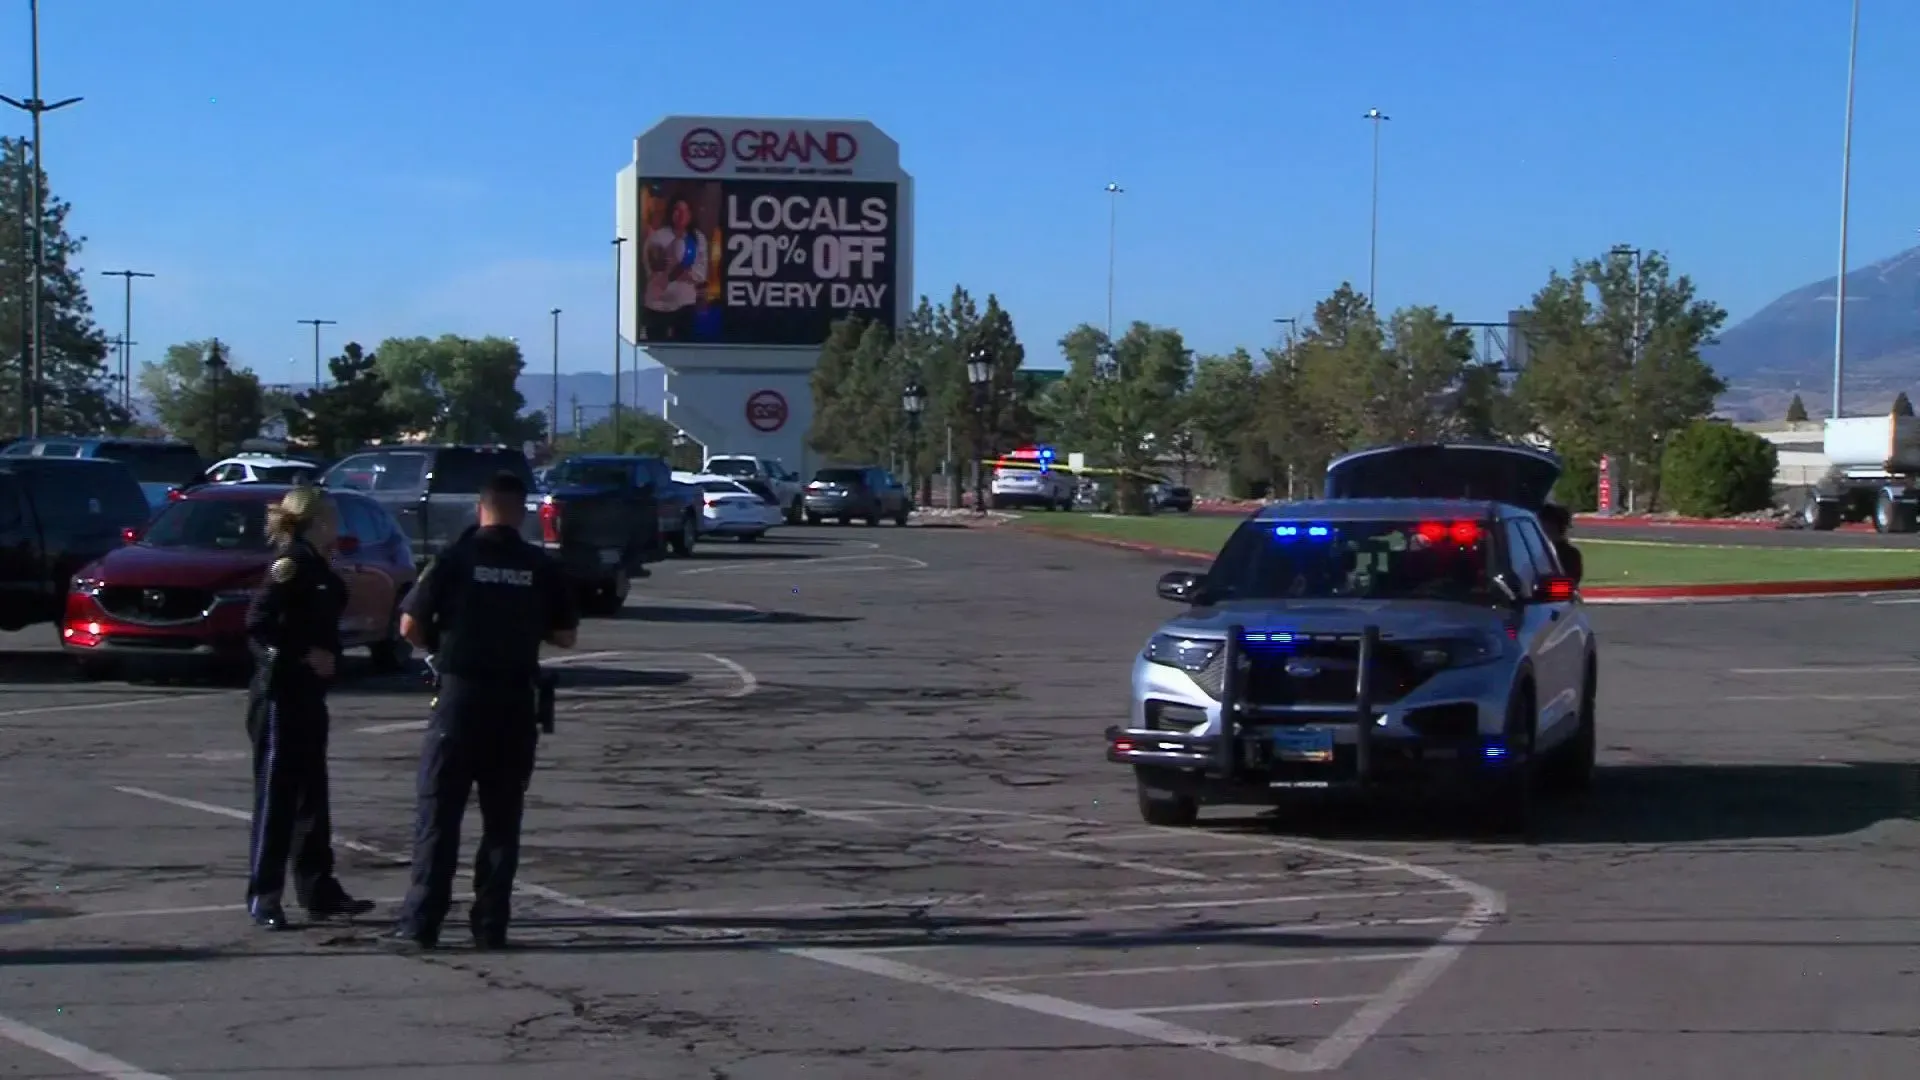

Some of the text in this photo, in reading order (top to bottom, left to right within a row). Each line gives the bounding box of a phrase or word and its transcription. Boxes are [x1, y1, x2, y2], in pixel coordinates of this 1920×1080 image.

[732, 129, 858, 164] GRAND
[727, 194, 888, 232] LOCALS
[727, 234, 887, 278] 20% OFF
[727, 281, 887, 308] EVERY DAY
[502, 568, 533, 586] POLICE
